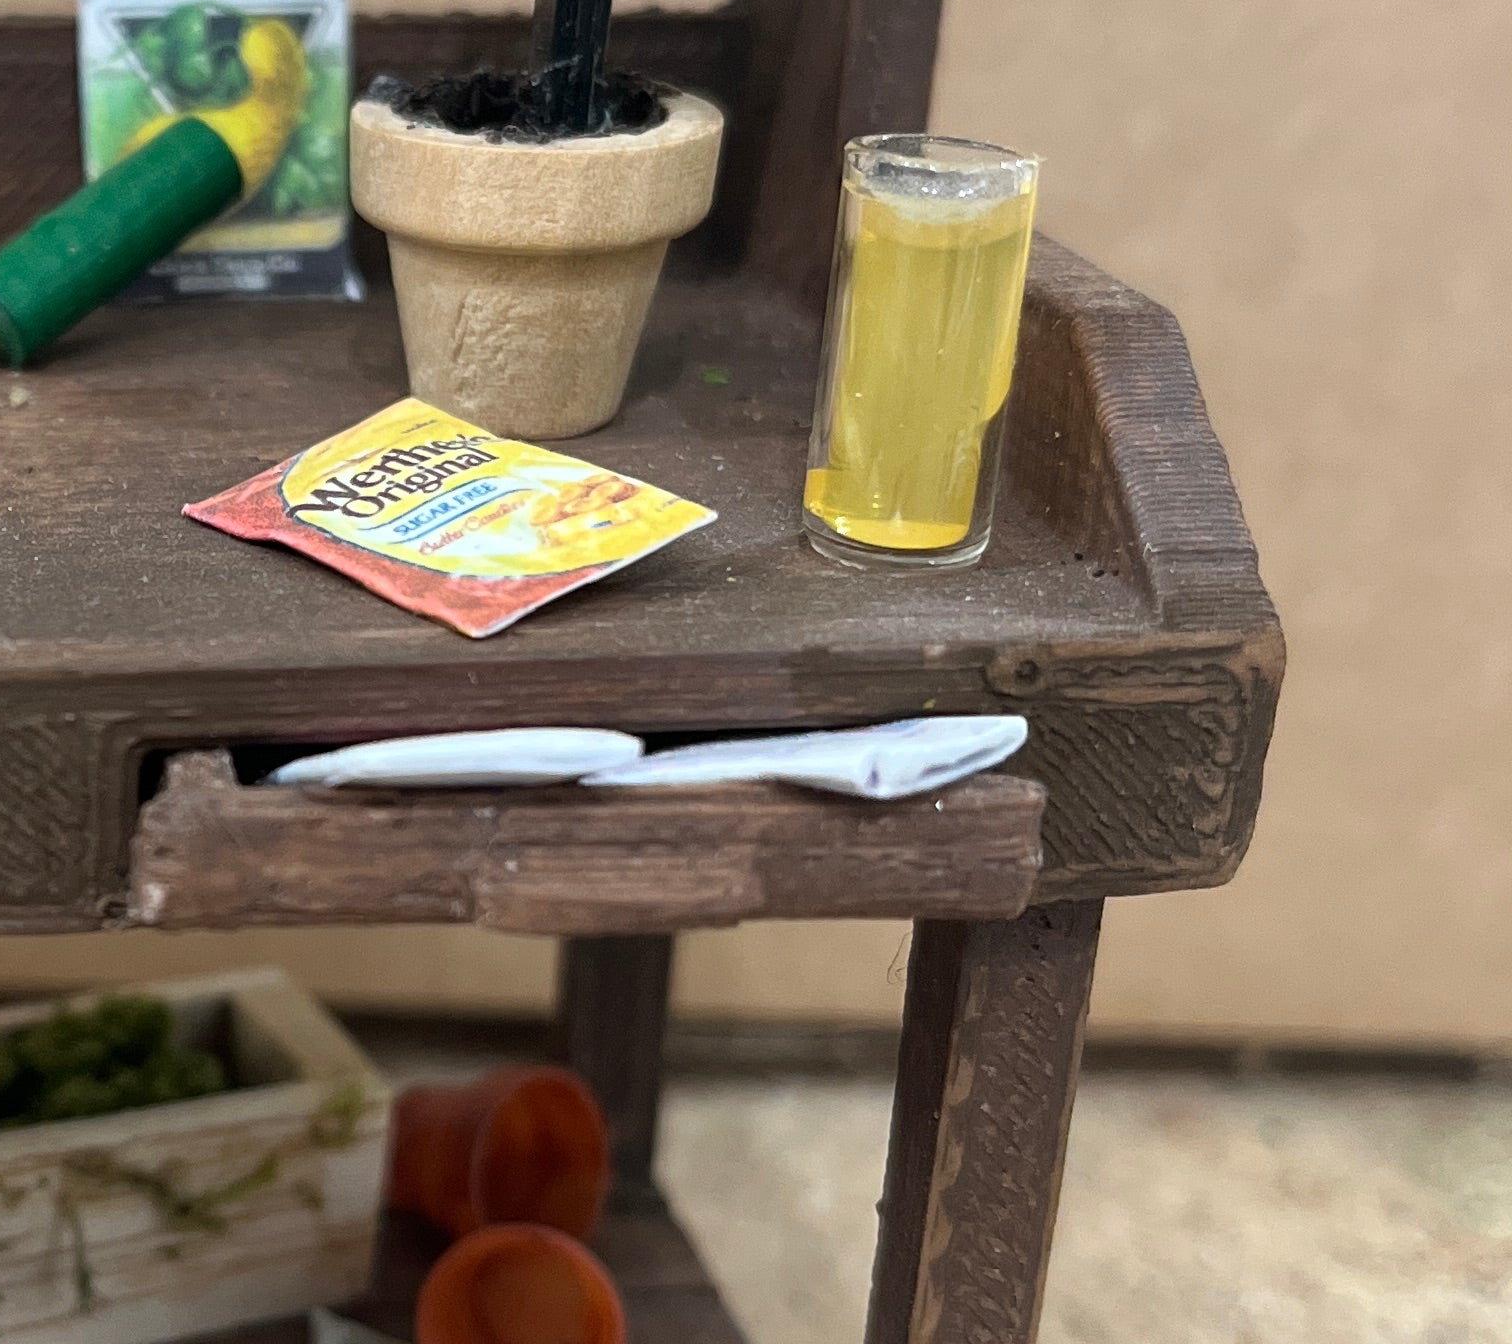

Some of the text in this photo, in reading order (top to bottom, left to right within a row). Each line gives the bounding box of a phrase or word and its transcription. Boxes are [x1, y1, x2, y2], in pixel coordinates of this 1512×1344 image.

[341, 446, 500, 519] Original
[393, 481, 498, 537] SUGAR FREE
